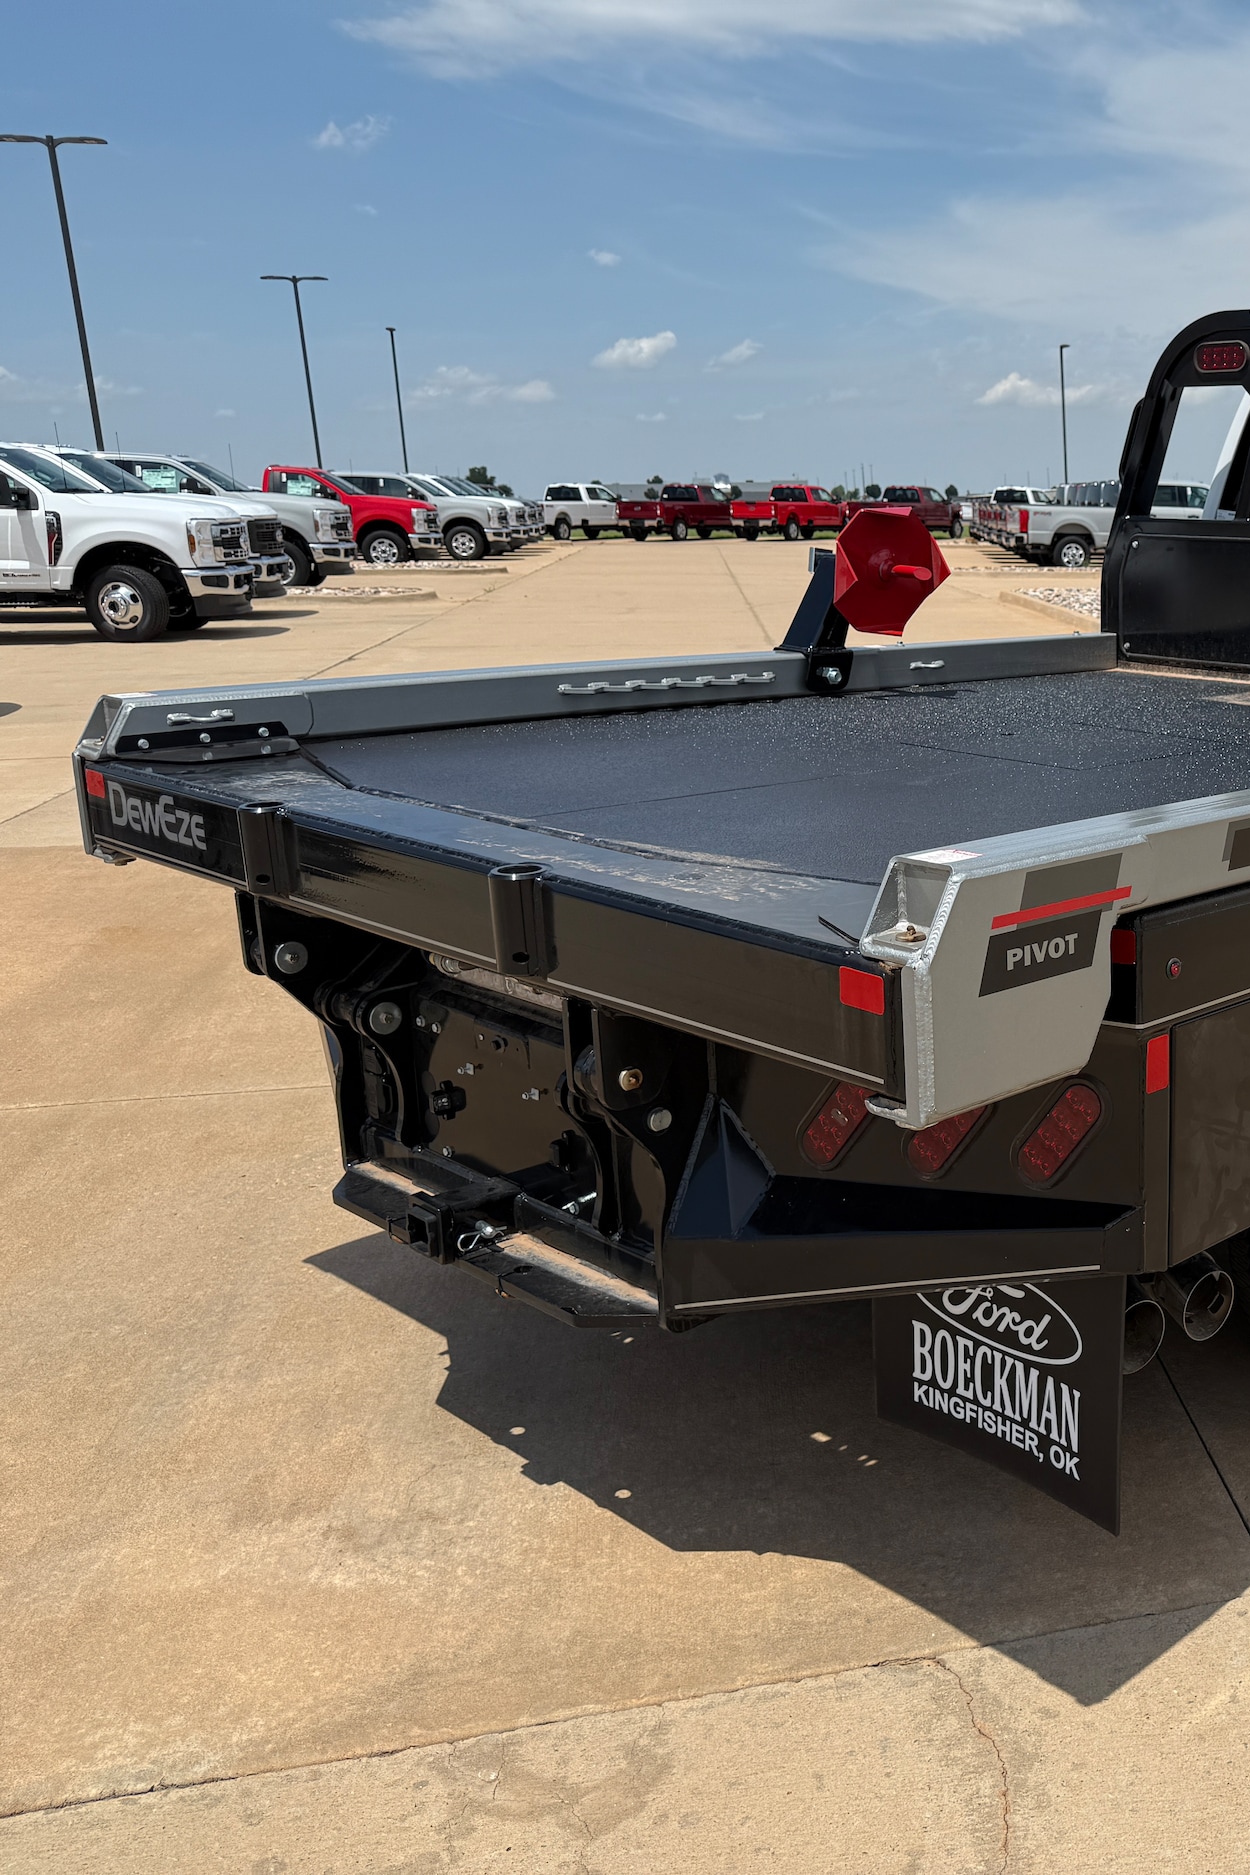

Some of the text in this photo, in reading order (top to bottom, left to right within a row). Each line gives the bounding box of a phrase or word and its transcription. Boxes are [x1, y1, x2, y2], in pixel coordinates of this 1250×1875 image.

[1006, 933, 1079, 971] PIVOT
[942, 1284, 1051, 1351] Ford
[912, 1320, 1081, 1453] BOECKMAN
[913, 1381, 1081, 1481] KINGFISHER, OK
